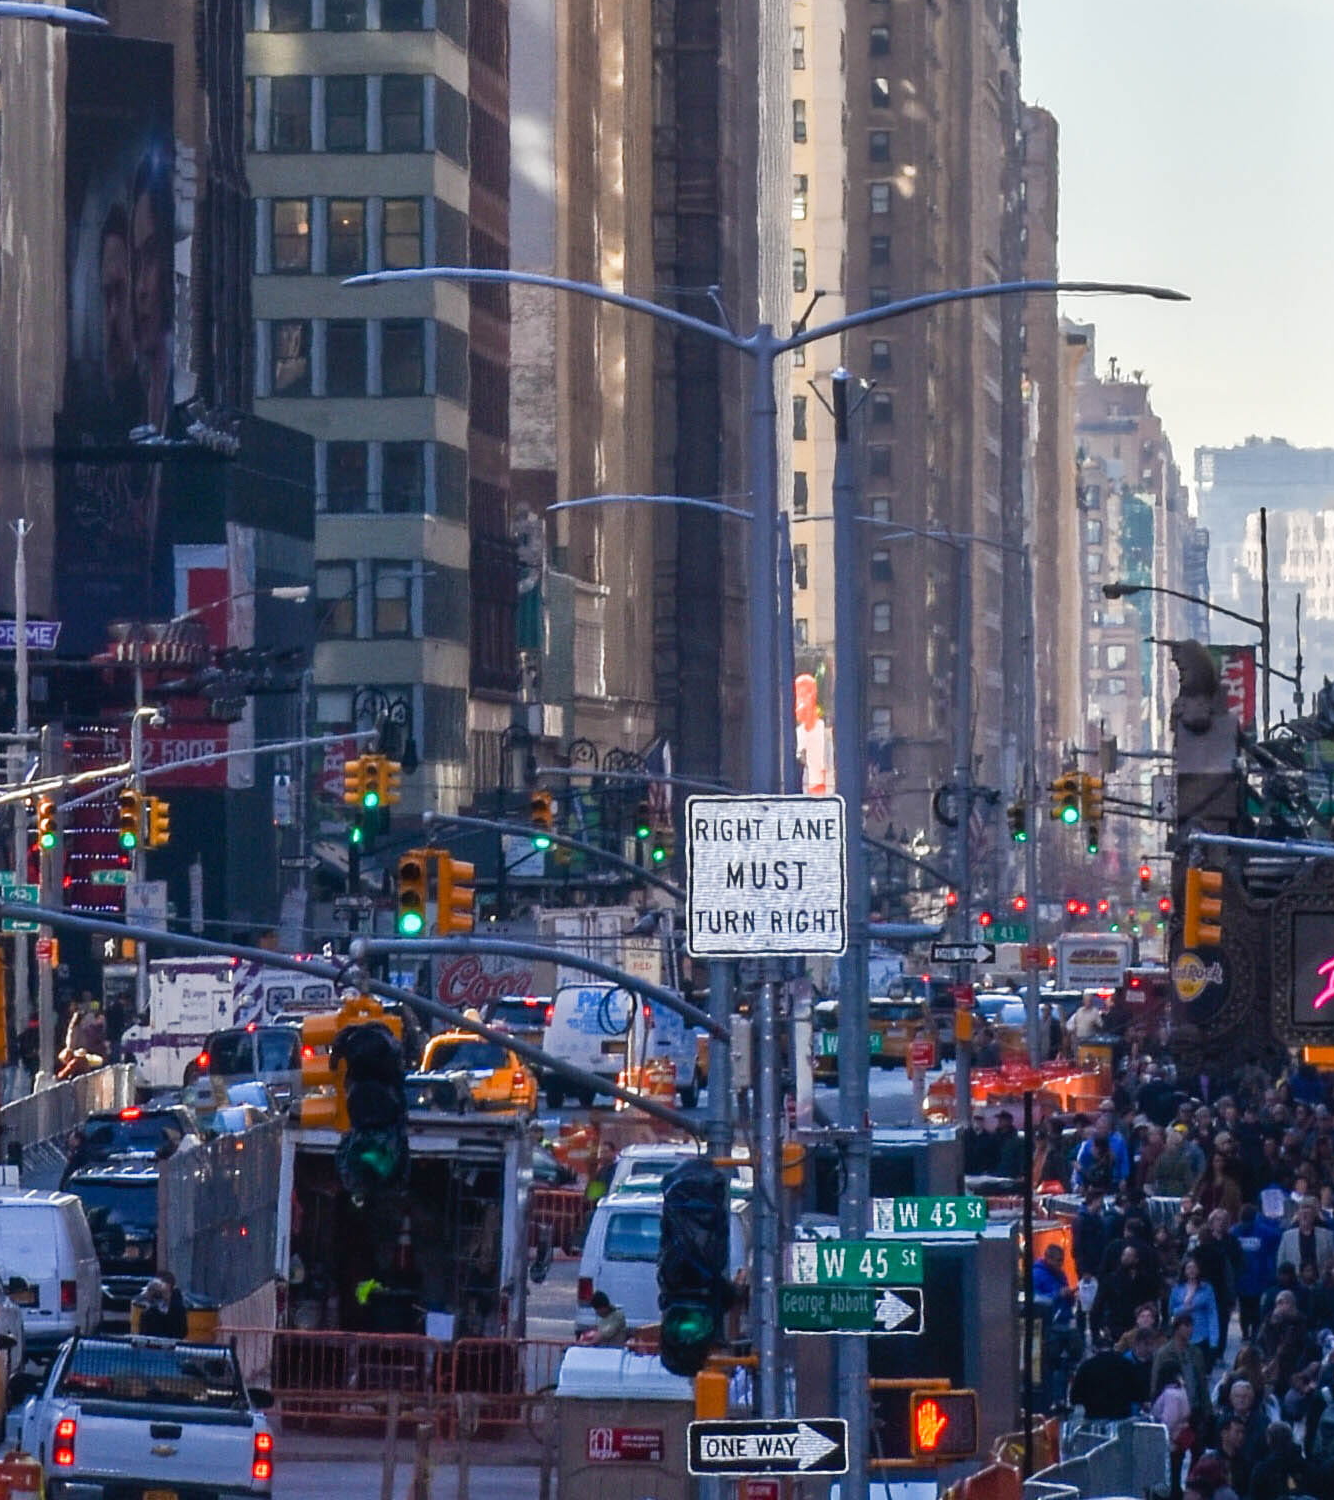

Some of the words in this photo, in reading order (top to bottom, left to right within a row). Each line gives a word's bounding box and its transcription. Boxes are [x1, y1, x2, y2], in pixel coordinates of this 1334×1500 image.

[695, 818, 764, 841] RIGHT
[777, 818, 837, 841] LANE
[726, 861, 808, 890] MUST
[695, 910, 755, 933] TURN
[770, 910, 840, 933] RIGHT
[898, 1202, 919, 1228] W
[929, 1202, 957, 1228] 45
[966, 1202, 982, 1219] St
[822, 1247, 846, 1279] W
[859, 1247, 889, 1279] 45
[901, 1248, 917, 1266] St
[783, 1291, 826, 1318] George
[830, 1291, 869, 1313] Abbott
[706, 1437, 747, 1458] ONE
[756, 1435, 798, 1457] WAY
